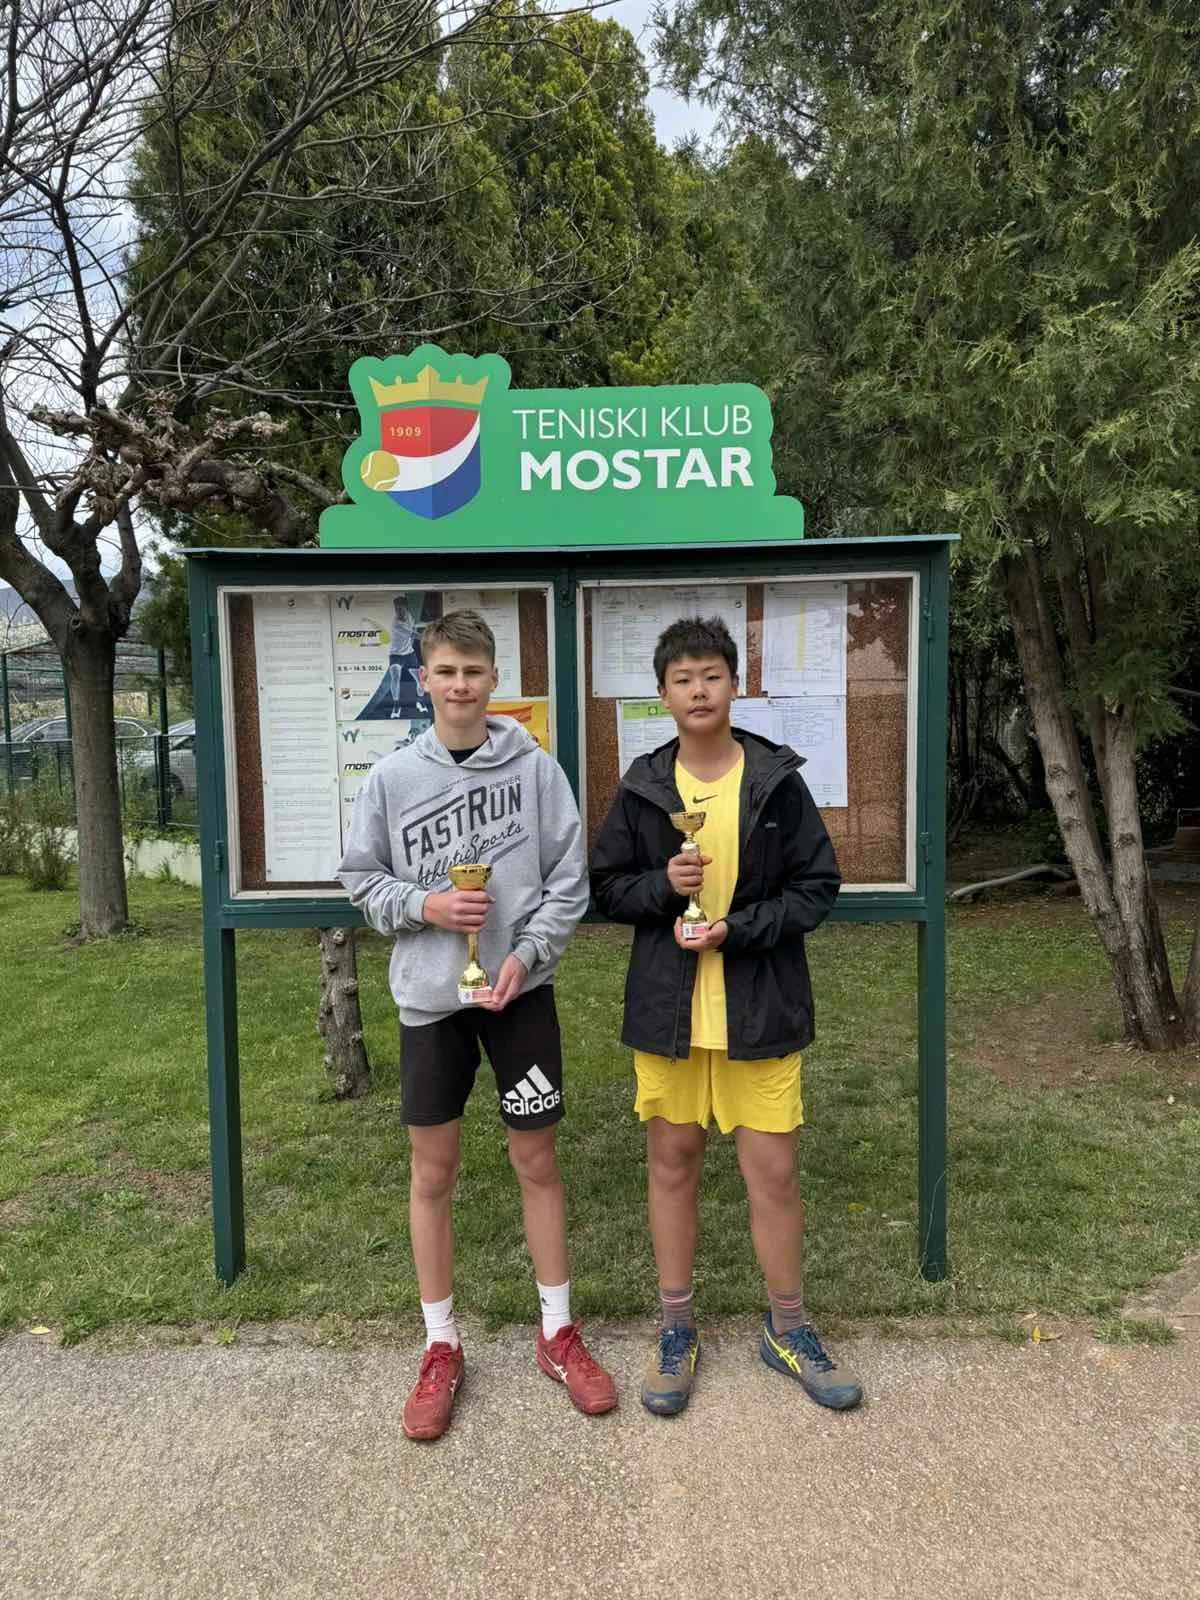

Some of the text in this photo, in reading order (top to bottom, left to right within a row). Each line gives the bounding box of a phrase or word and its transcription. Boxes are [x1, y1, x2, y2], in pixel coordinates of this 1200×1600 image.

[390, 426, 421, 437] 1909
[512, 404, 753, 439] TENISKI KLUB
[520, 447, 755, 491] MOSTAR
[502, 1090, 560, 1115] adidas
